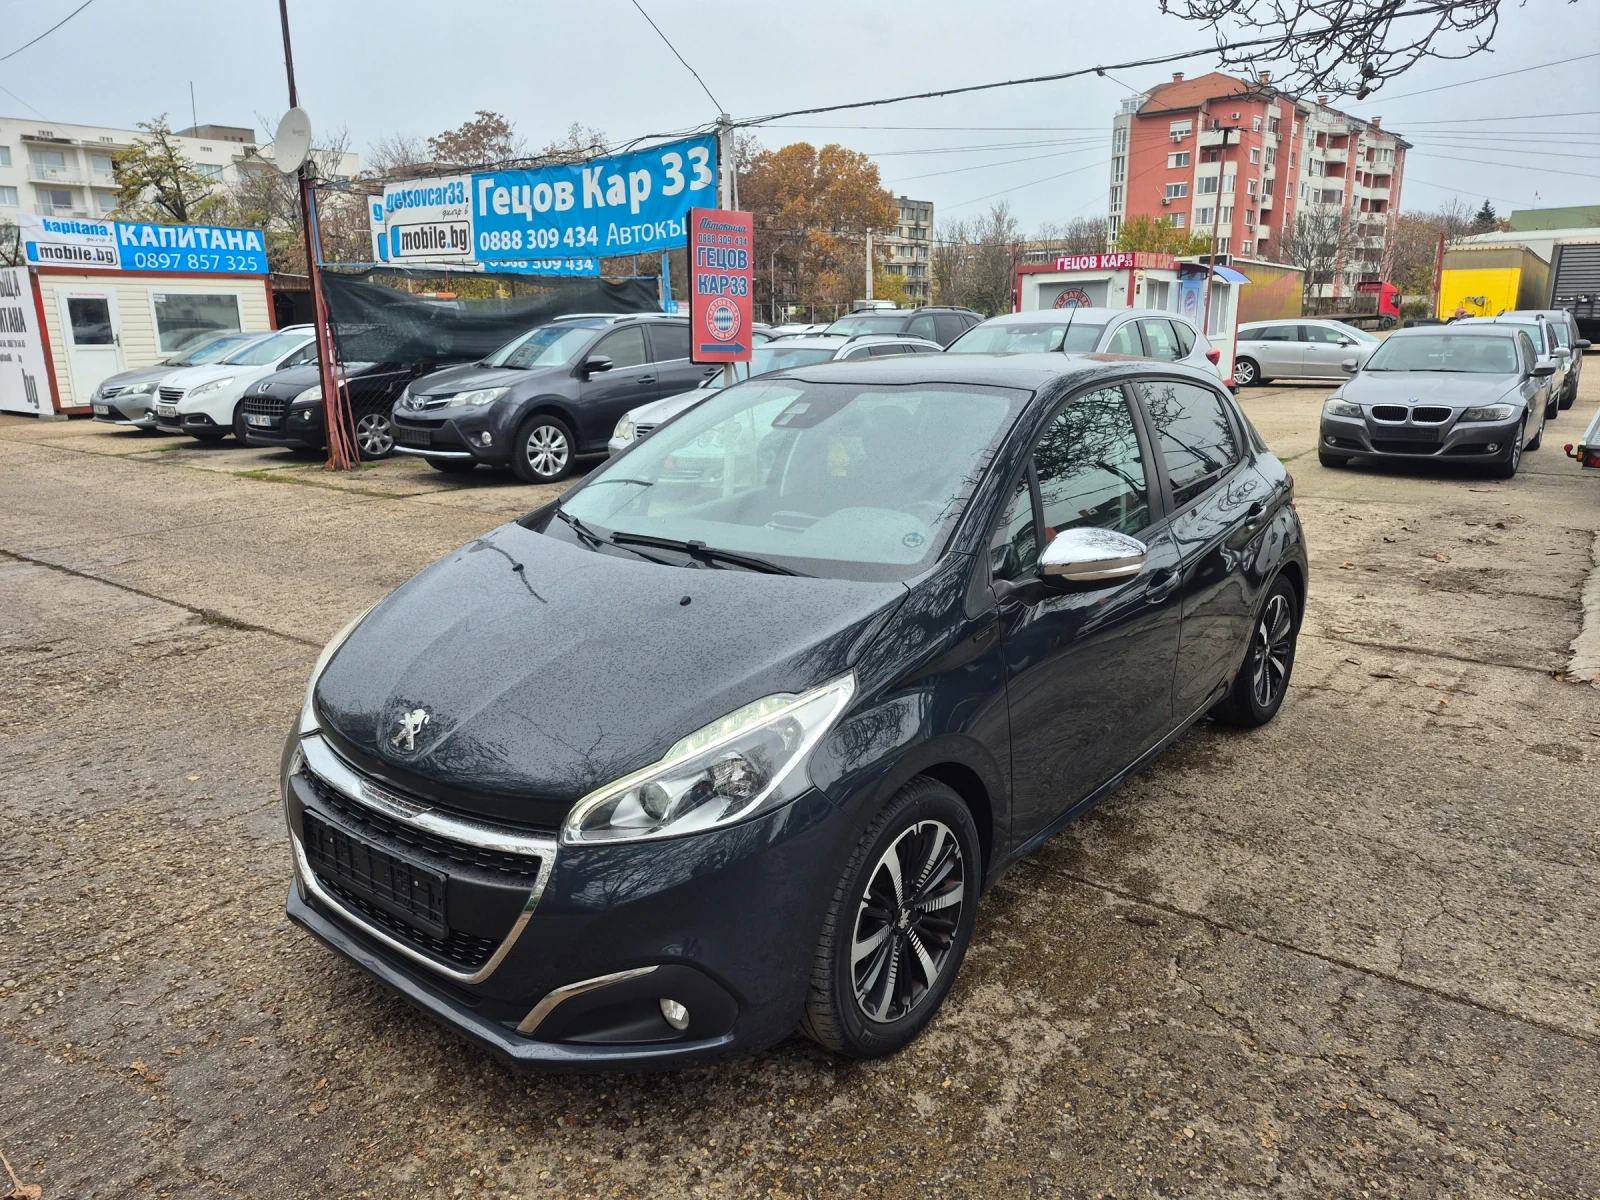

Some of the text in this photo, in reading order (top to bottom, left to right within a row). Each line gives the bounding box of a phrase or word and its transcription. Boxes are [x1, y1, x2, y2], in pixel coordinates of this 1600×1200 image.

[478, 147, 713, 221] Гецов Кар 33
[119, 224, 262, 251] КАПИТАНА
[401, 225, 467, 251] mobile.bg
[480, 229, 523, 251] 0888
[527, 228, 559, 248] 309
[563, 226, 598, 247] 434
[698, 233, 747, 246] 0888 309 434
[39, 246, 114, 263] mobile.bg
[134, 252, 258, 271] 0897 857 325
[697, 246, 748, 271] ГЕЦОВ
[1057, 256, 1097, 270] ГЕЦОВ
[1101, 254, 1125, 268] КАР
